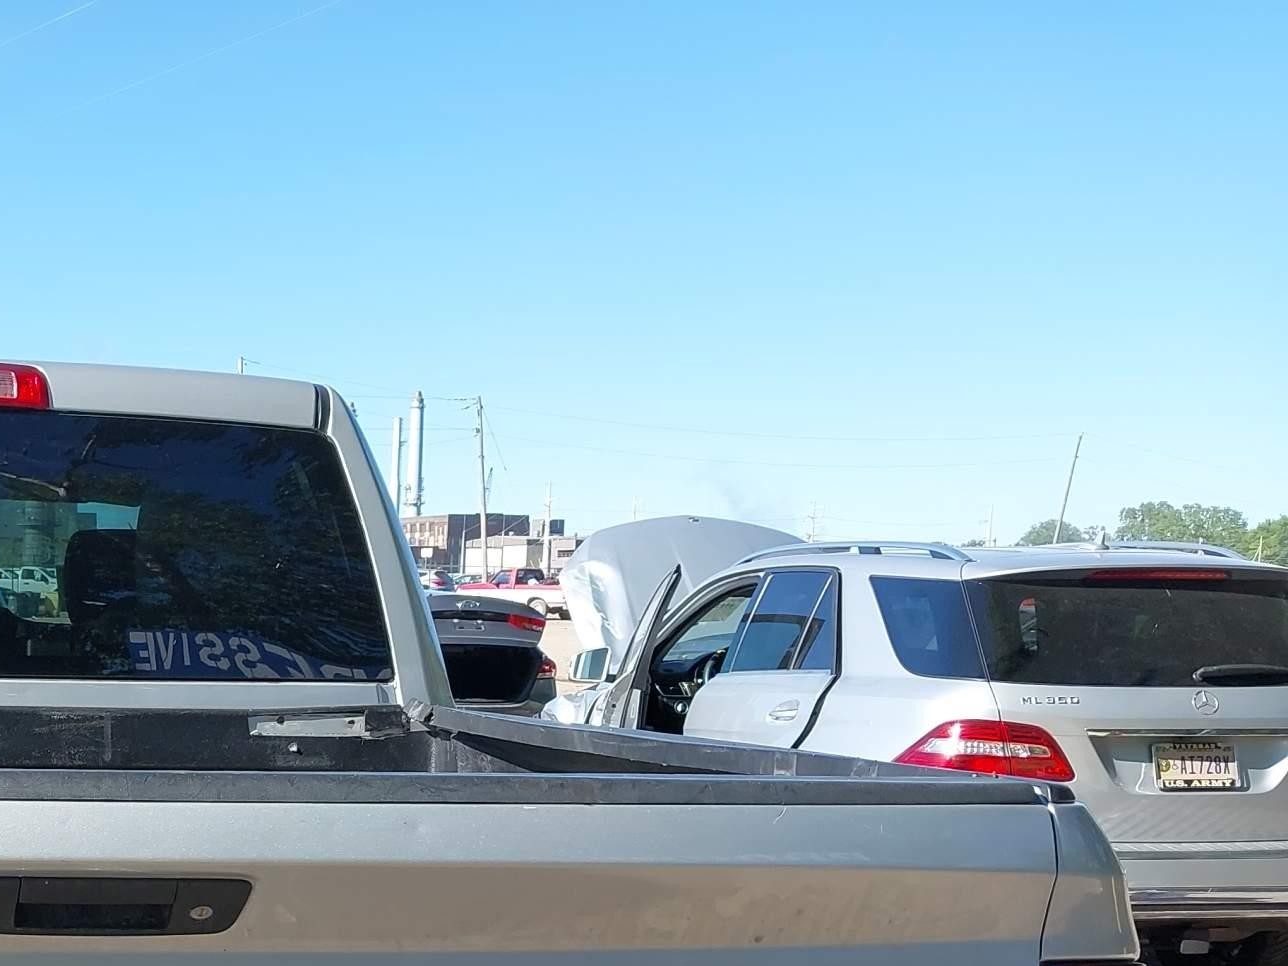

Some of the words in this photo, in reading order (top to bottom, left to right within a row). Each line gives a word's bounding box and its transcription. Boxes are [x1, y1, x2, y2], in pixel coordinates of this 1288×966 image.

[1022, 696, 1043, 706] ML
[1045, 696, 1081, 706] 350
[1180, 755, 1231, 775] AI728X
[1164, 780, 1189, 788] U.S.
[1190, 780, 1234, 788] ARMY
